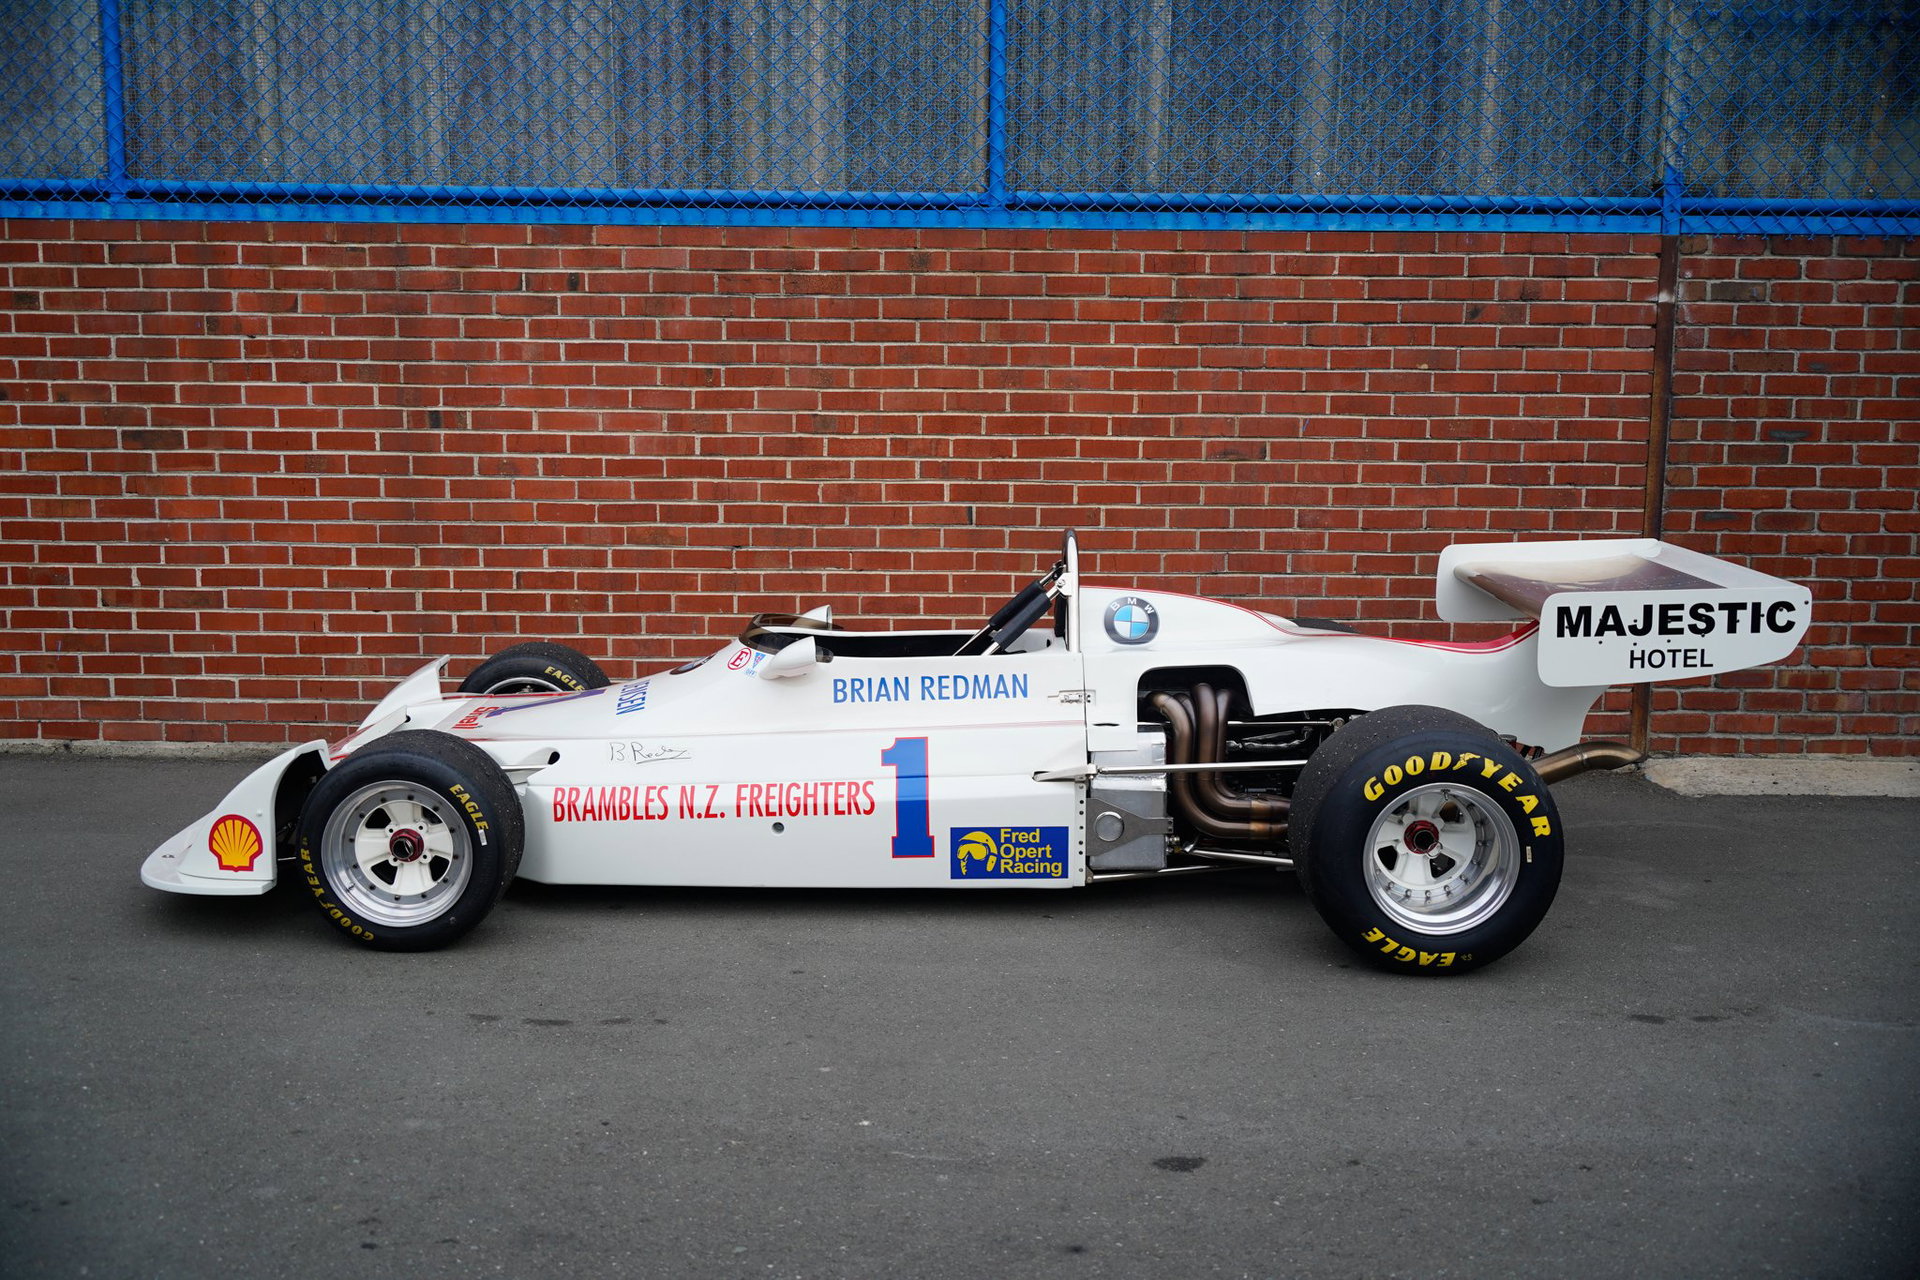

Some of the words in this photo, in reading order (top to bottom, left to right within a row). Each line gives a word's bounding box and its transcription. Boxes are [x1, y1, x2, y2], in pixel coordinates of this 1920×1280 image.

[1110, 597, 1154, 614] BMW
[1556, 600, 1796, 639] MAJESTIC
[1629, 648, 1713, 669] HOTEL
[544, 666, 585, 692] EAGLE
[833, 676, 910, 704] BRIAN
[921, 673, 1028, 701] REDMAN
[450, 784, 489, 830] EAGLE
[553, 786, 669, 822] BRAMBLES
[679, 784, 725, 819] N.Z.
[736, 780, 876, 818] FREIGHTERS
[881, 736, 935, 859] 1
[1363, 751, 1551, 837] GOODYEAR
[1000, 828, 1040, 843] Fred
[1000, 843, 1052, 861] Opert
[1000, 859, 1062, 877] Racing
[301, 848, 375, 940] GOODYEAR
[1361, 927, 1456, 967] EAGLE
